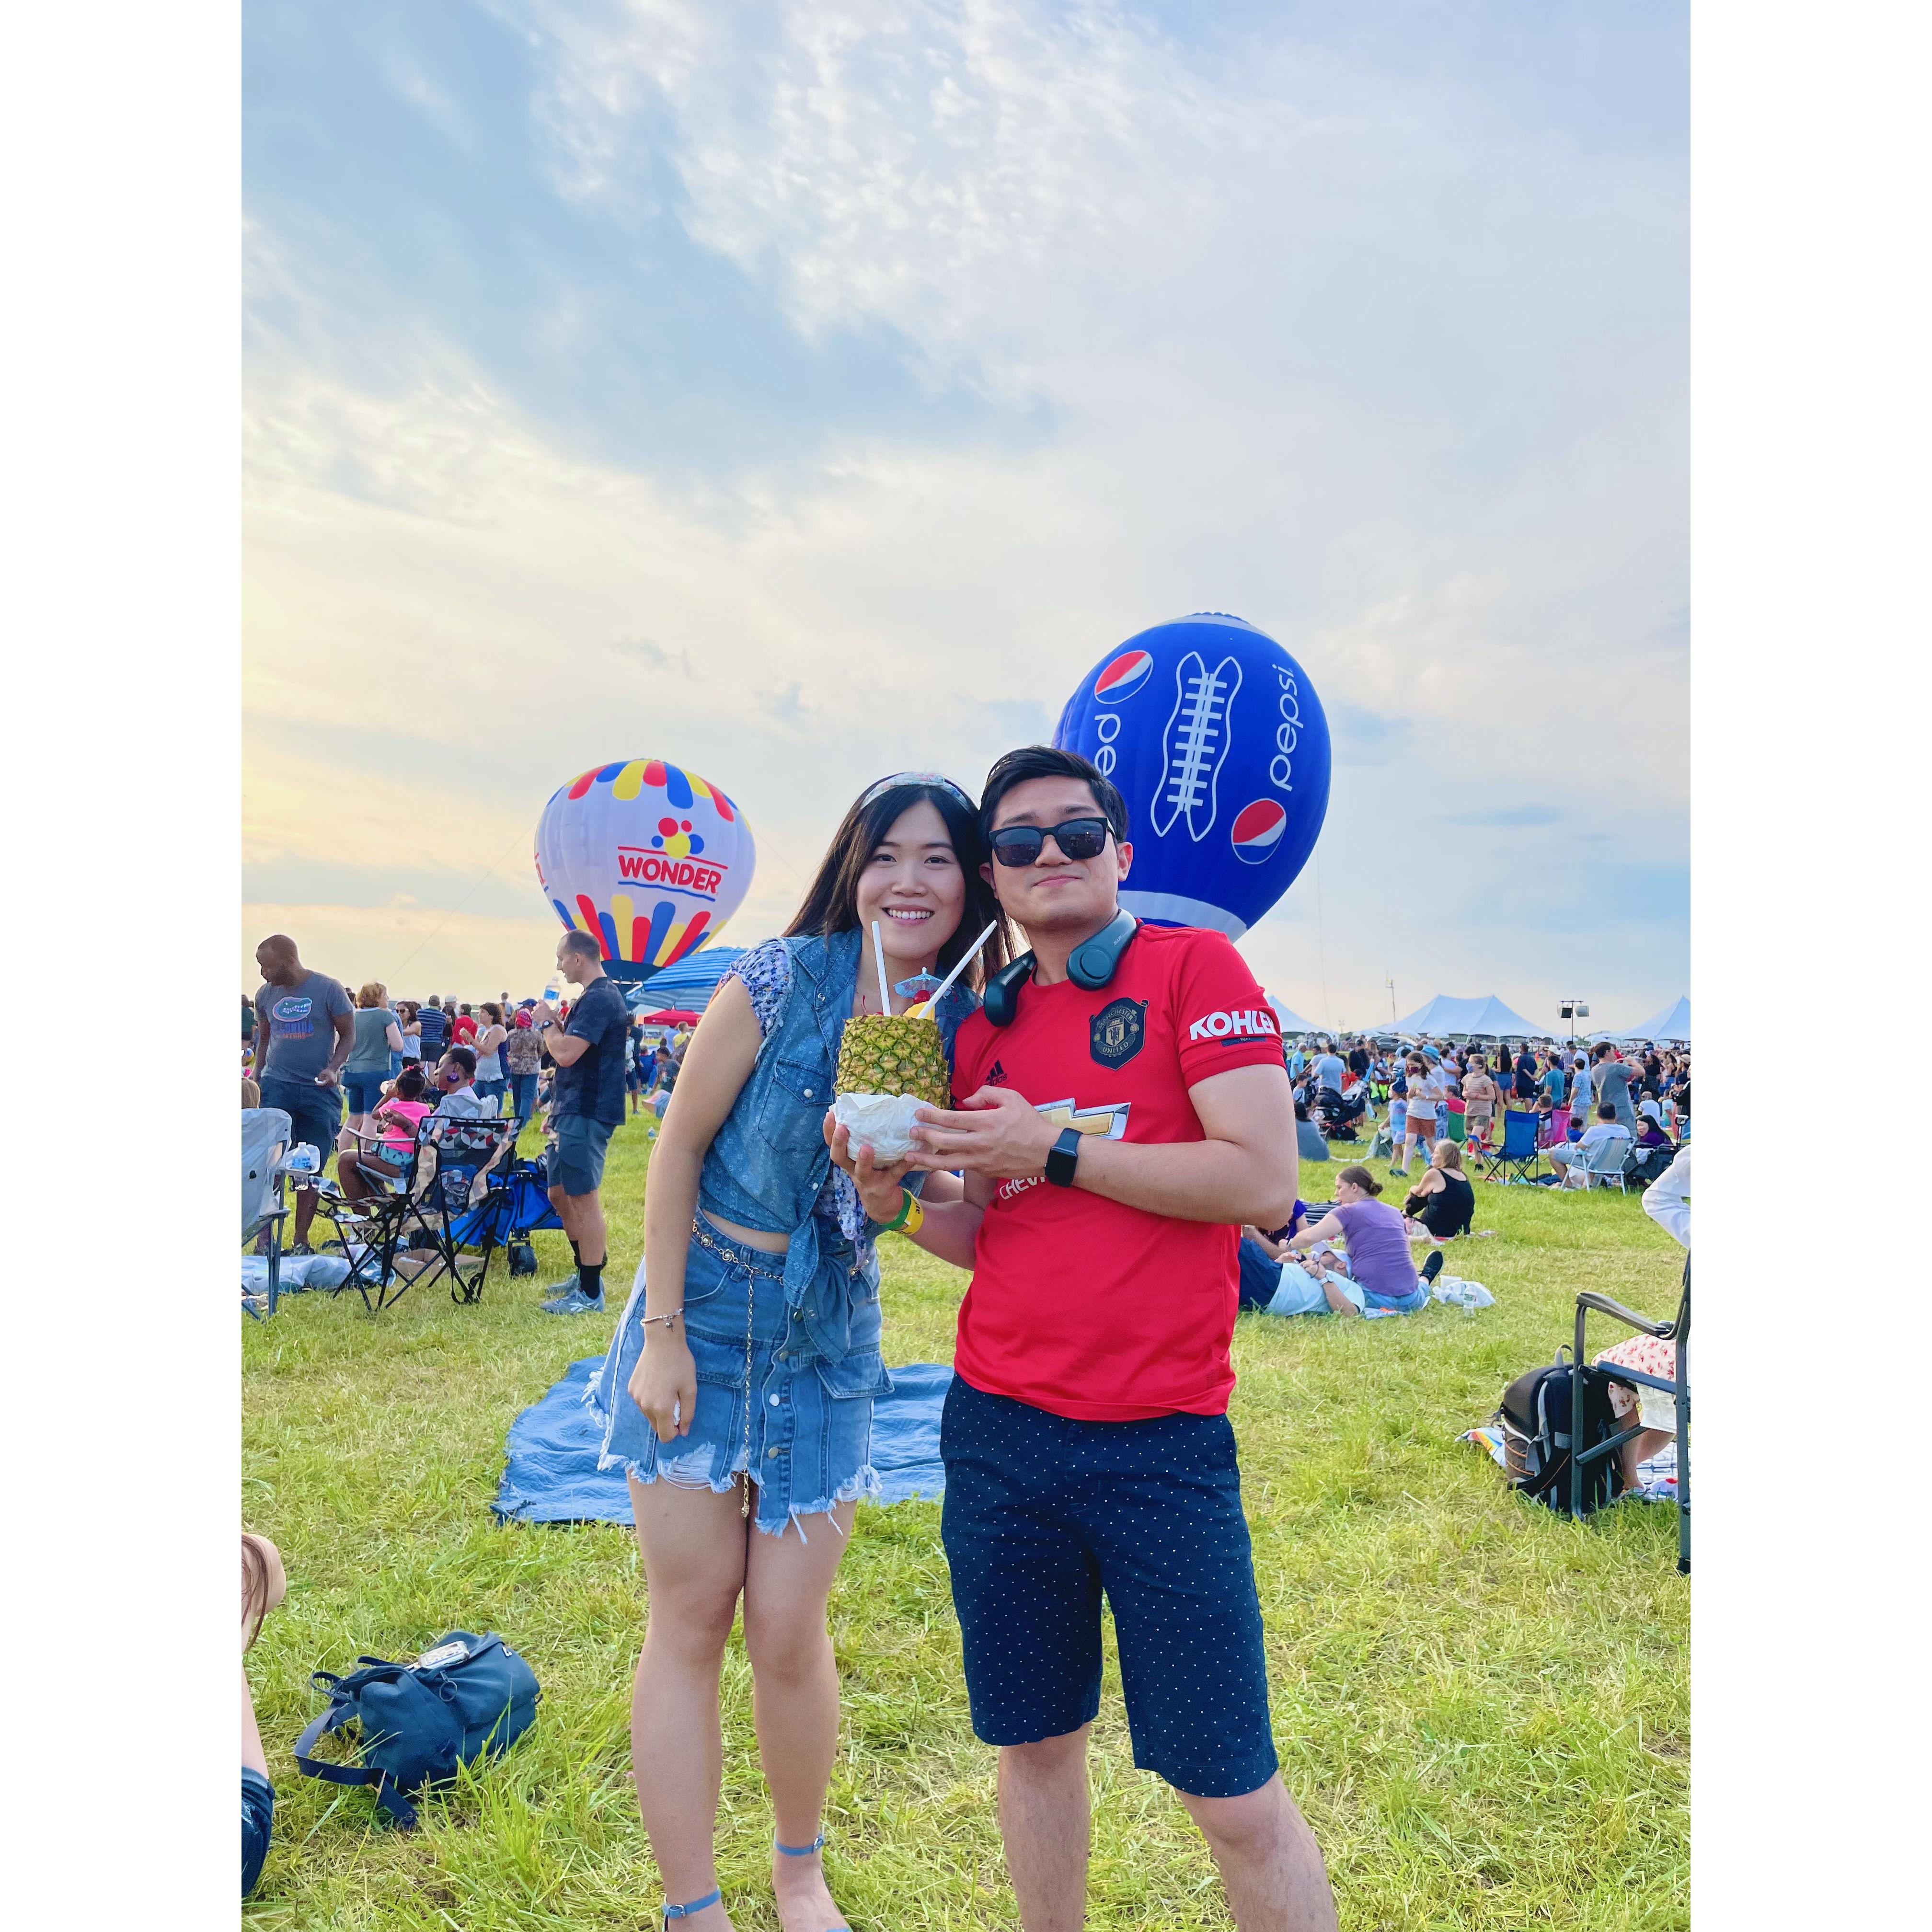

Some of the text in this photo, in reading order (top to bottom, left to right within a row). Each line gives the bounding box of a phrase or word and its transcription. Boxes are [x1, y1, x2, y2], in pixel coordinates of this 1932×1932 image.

[1269, 663, 1304, 792] pepsi
[618, 855, 722, 894] WONDER
[1097, 1008, 1134, 1030] MANCHESTER
[1102, 1042, 1128, 1054] UNITED
